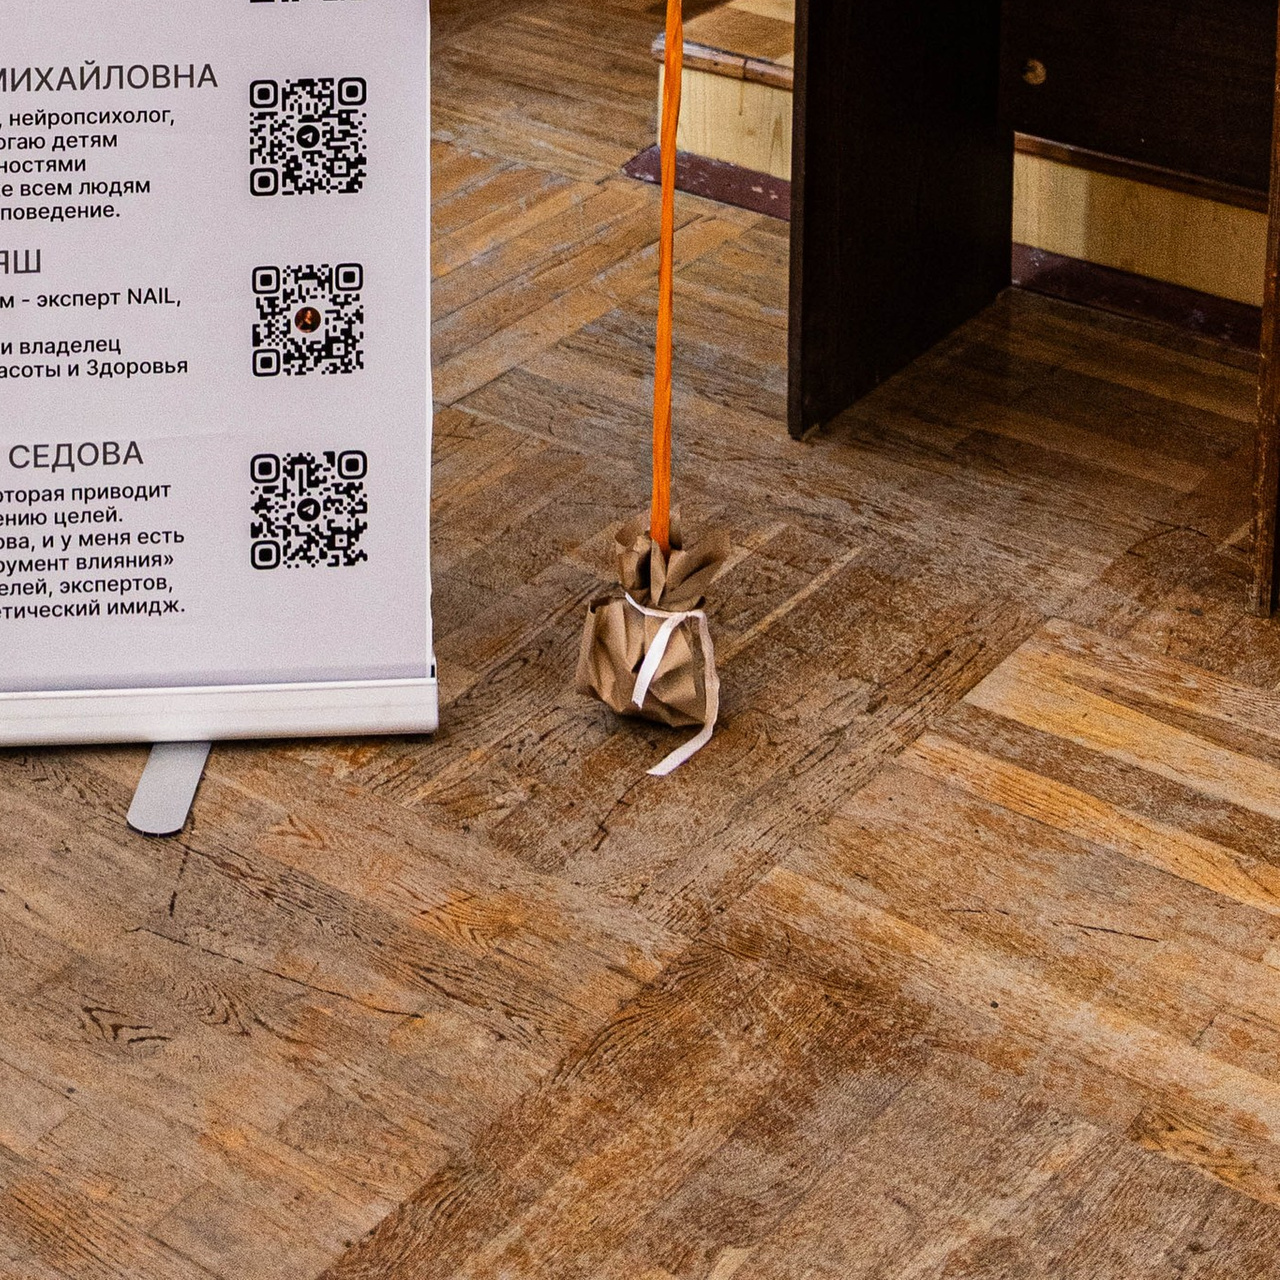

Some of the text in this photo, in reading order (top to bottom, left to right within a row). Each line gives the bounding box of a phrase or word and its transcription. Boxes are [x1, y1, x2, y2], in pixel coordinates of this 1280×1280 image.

[9, 108, 175, 130] нейропсихолог,
[51, 133, 118, 152] детям
[20, 182, 73, 197] всем
[78, 179, 151, 198] людям
[0, 204, 121, 223] поведение.
[36, 291, 121, 311] эксперт
[127, 286, 182, 308] NAIL,
[0, 341, 13, 356] и
[19, 338, 122, 358] владелец
[67, 363, 80, 377] и
[86, 358, 189, 379] Здоровья
[8, 440, 144, 474] СЕДОВА
[71, 484, 172, 505] приводит
[54, 505, 123, 528] целей.
[42, 535, 54, 549] и
[60, 534, 72, 552] у
[78, 531, 131, 547] меня
[137, 530, 185, 545] есть
[76, 553, 174, 571] влияния»
[59, 576, 173, 596] экспертов,
[107, 599, 186, 617] имидж.
